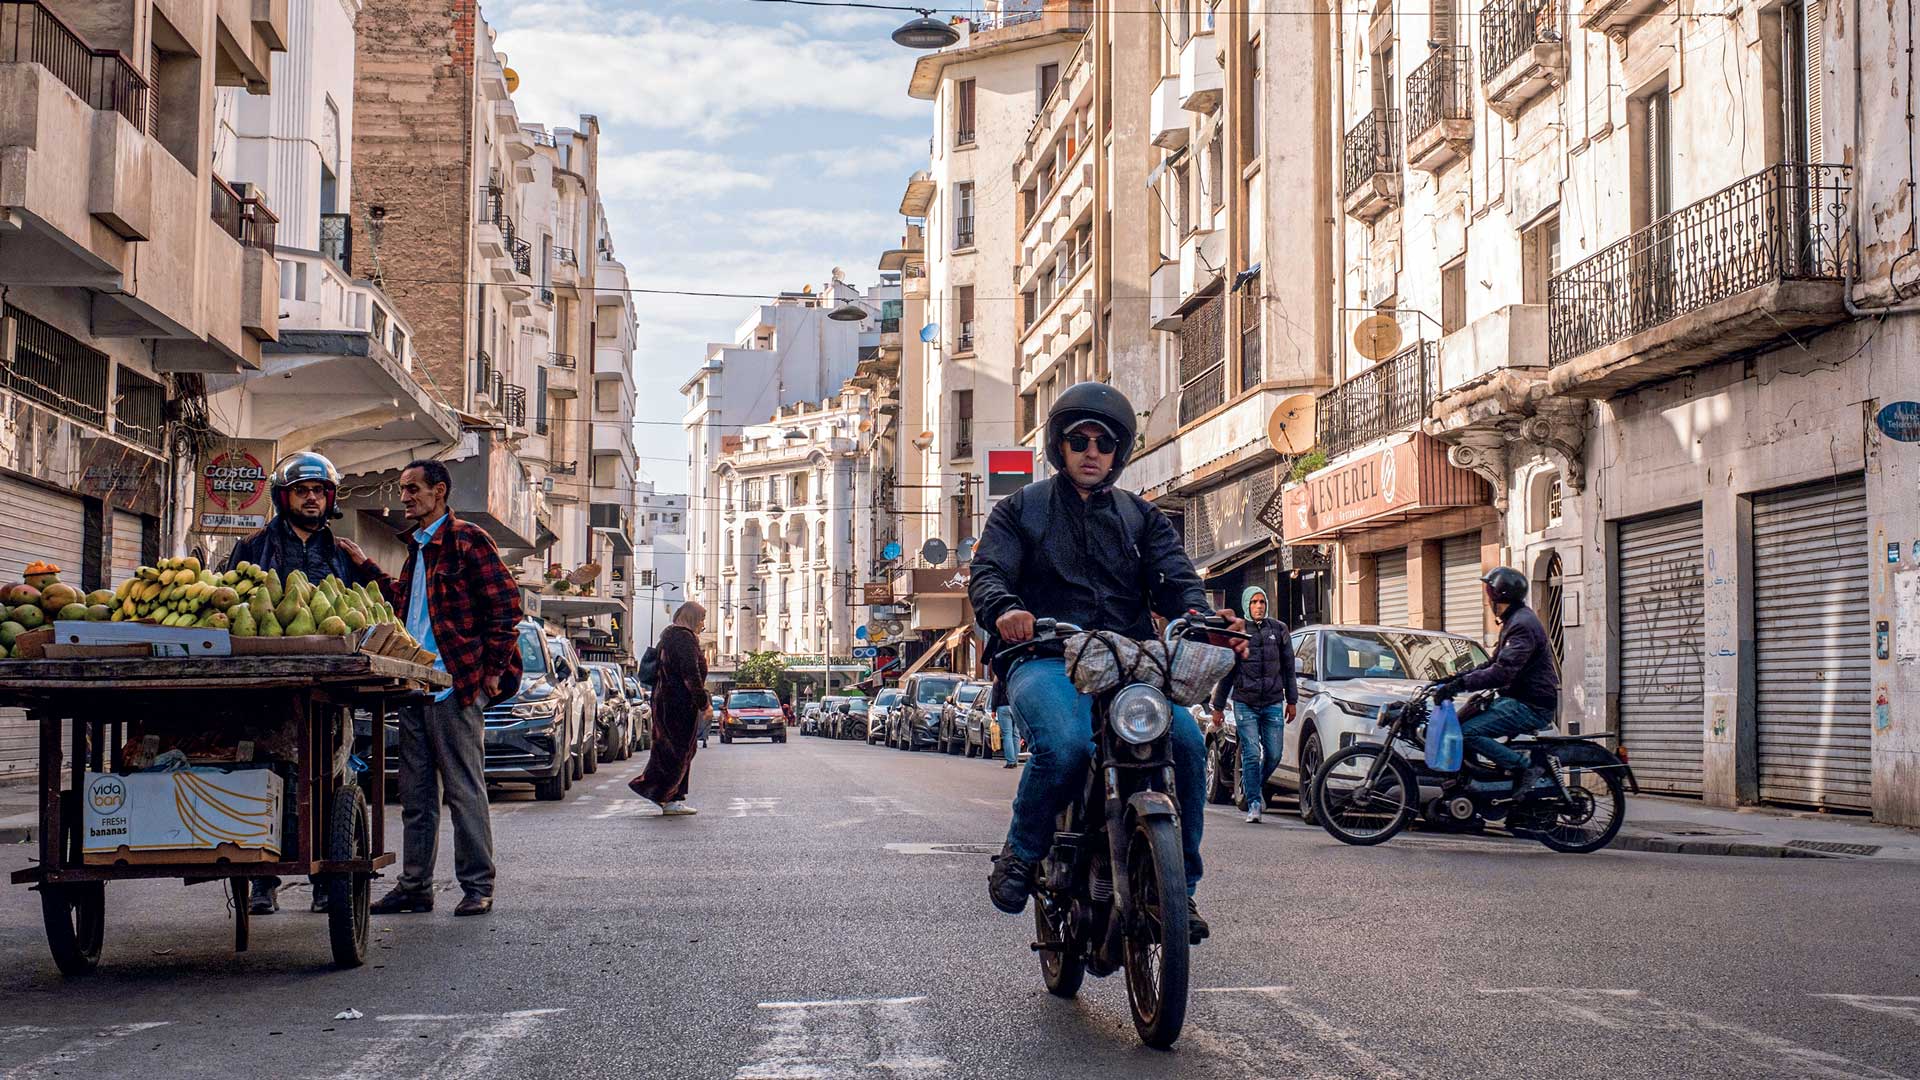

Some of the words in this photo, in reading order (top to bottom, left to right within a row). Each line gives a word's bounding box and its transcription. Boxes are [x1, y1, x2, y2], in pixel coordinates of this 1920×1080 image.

[93, 783, 121, 795] vida
[102, 817, 127, 827] FRESH
[90, 827, 127, 837] bananas
